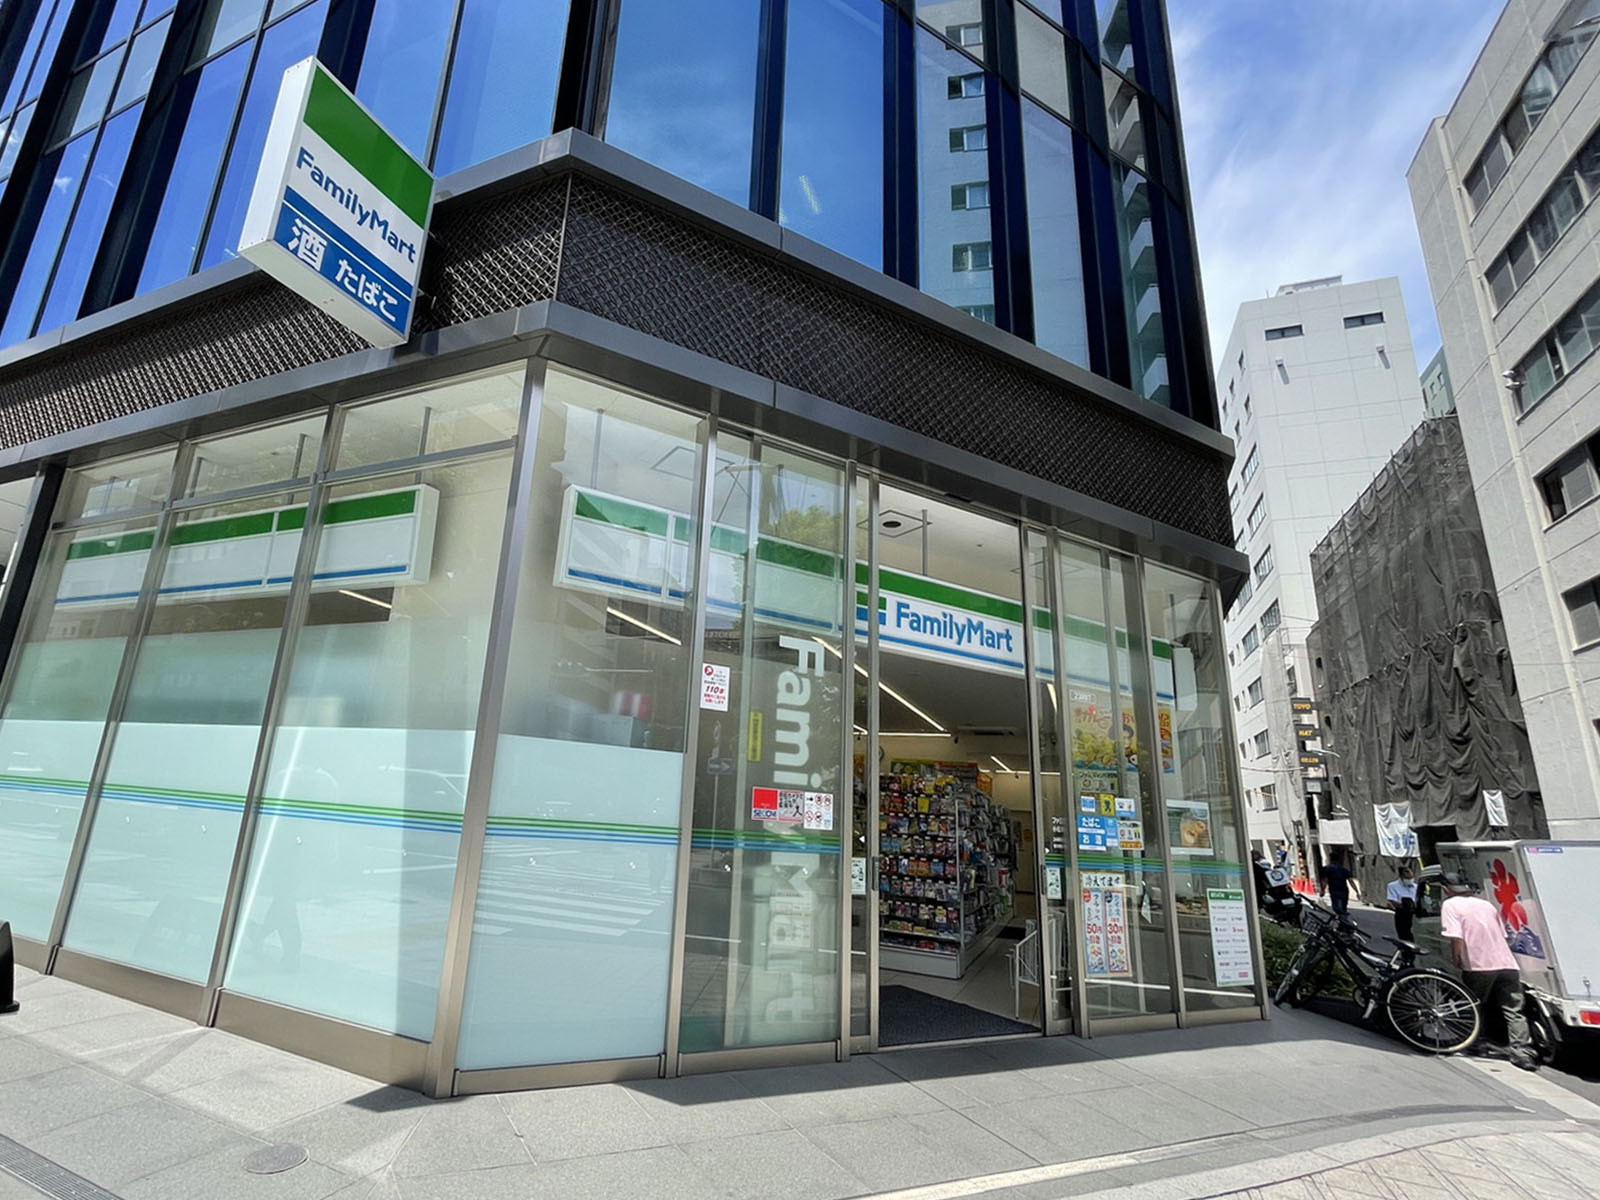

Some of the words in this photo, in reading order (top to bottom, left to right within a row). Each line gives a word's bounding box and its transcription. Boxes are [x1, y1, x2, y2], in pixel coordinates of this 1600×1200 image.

[296, 146, 415, 263] FamilyMart
[287, 217, 327, 272] 酒
[335, 258, 398, 322] たばこ
[896, 601, 1013, 652] FamilyMart
[762, 634, 825, 1024] FamiyMart
